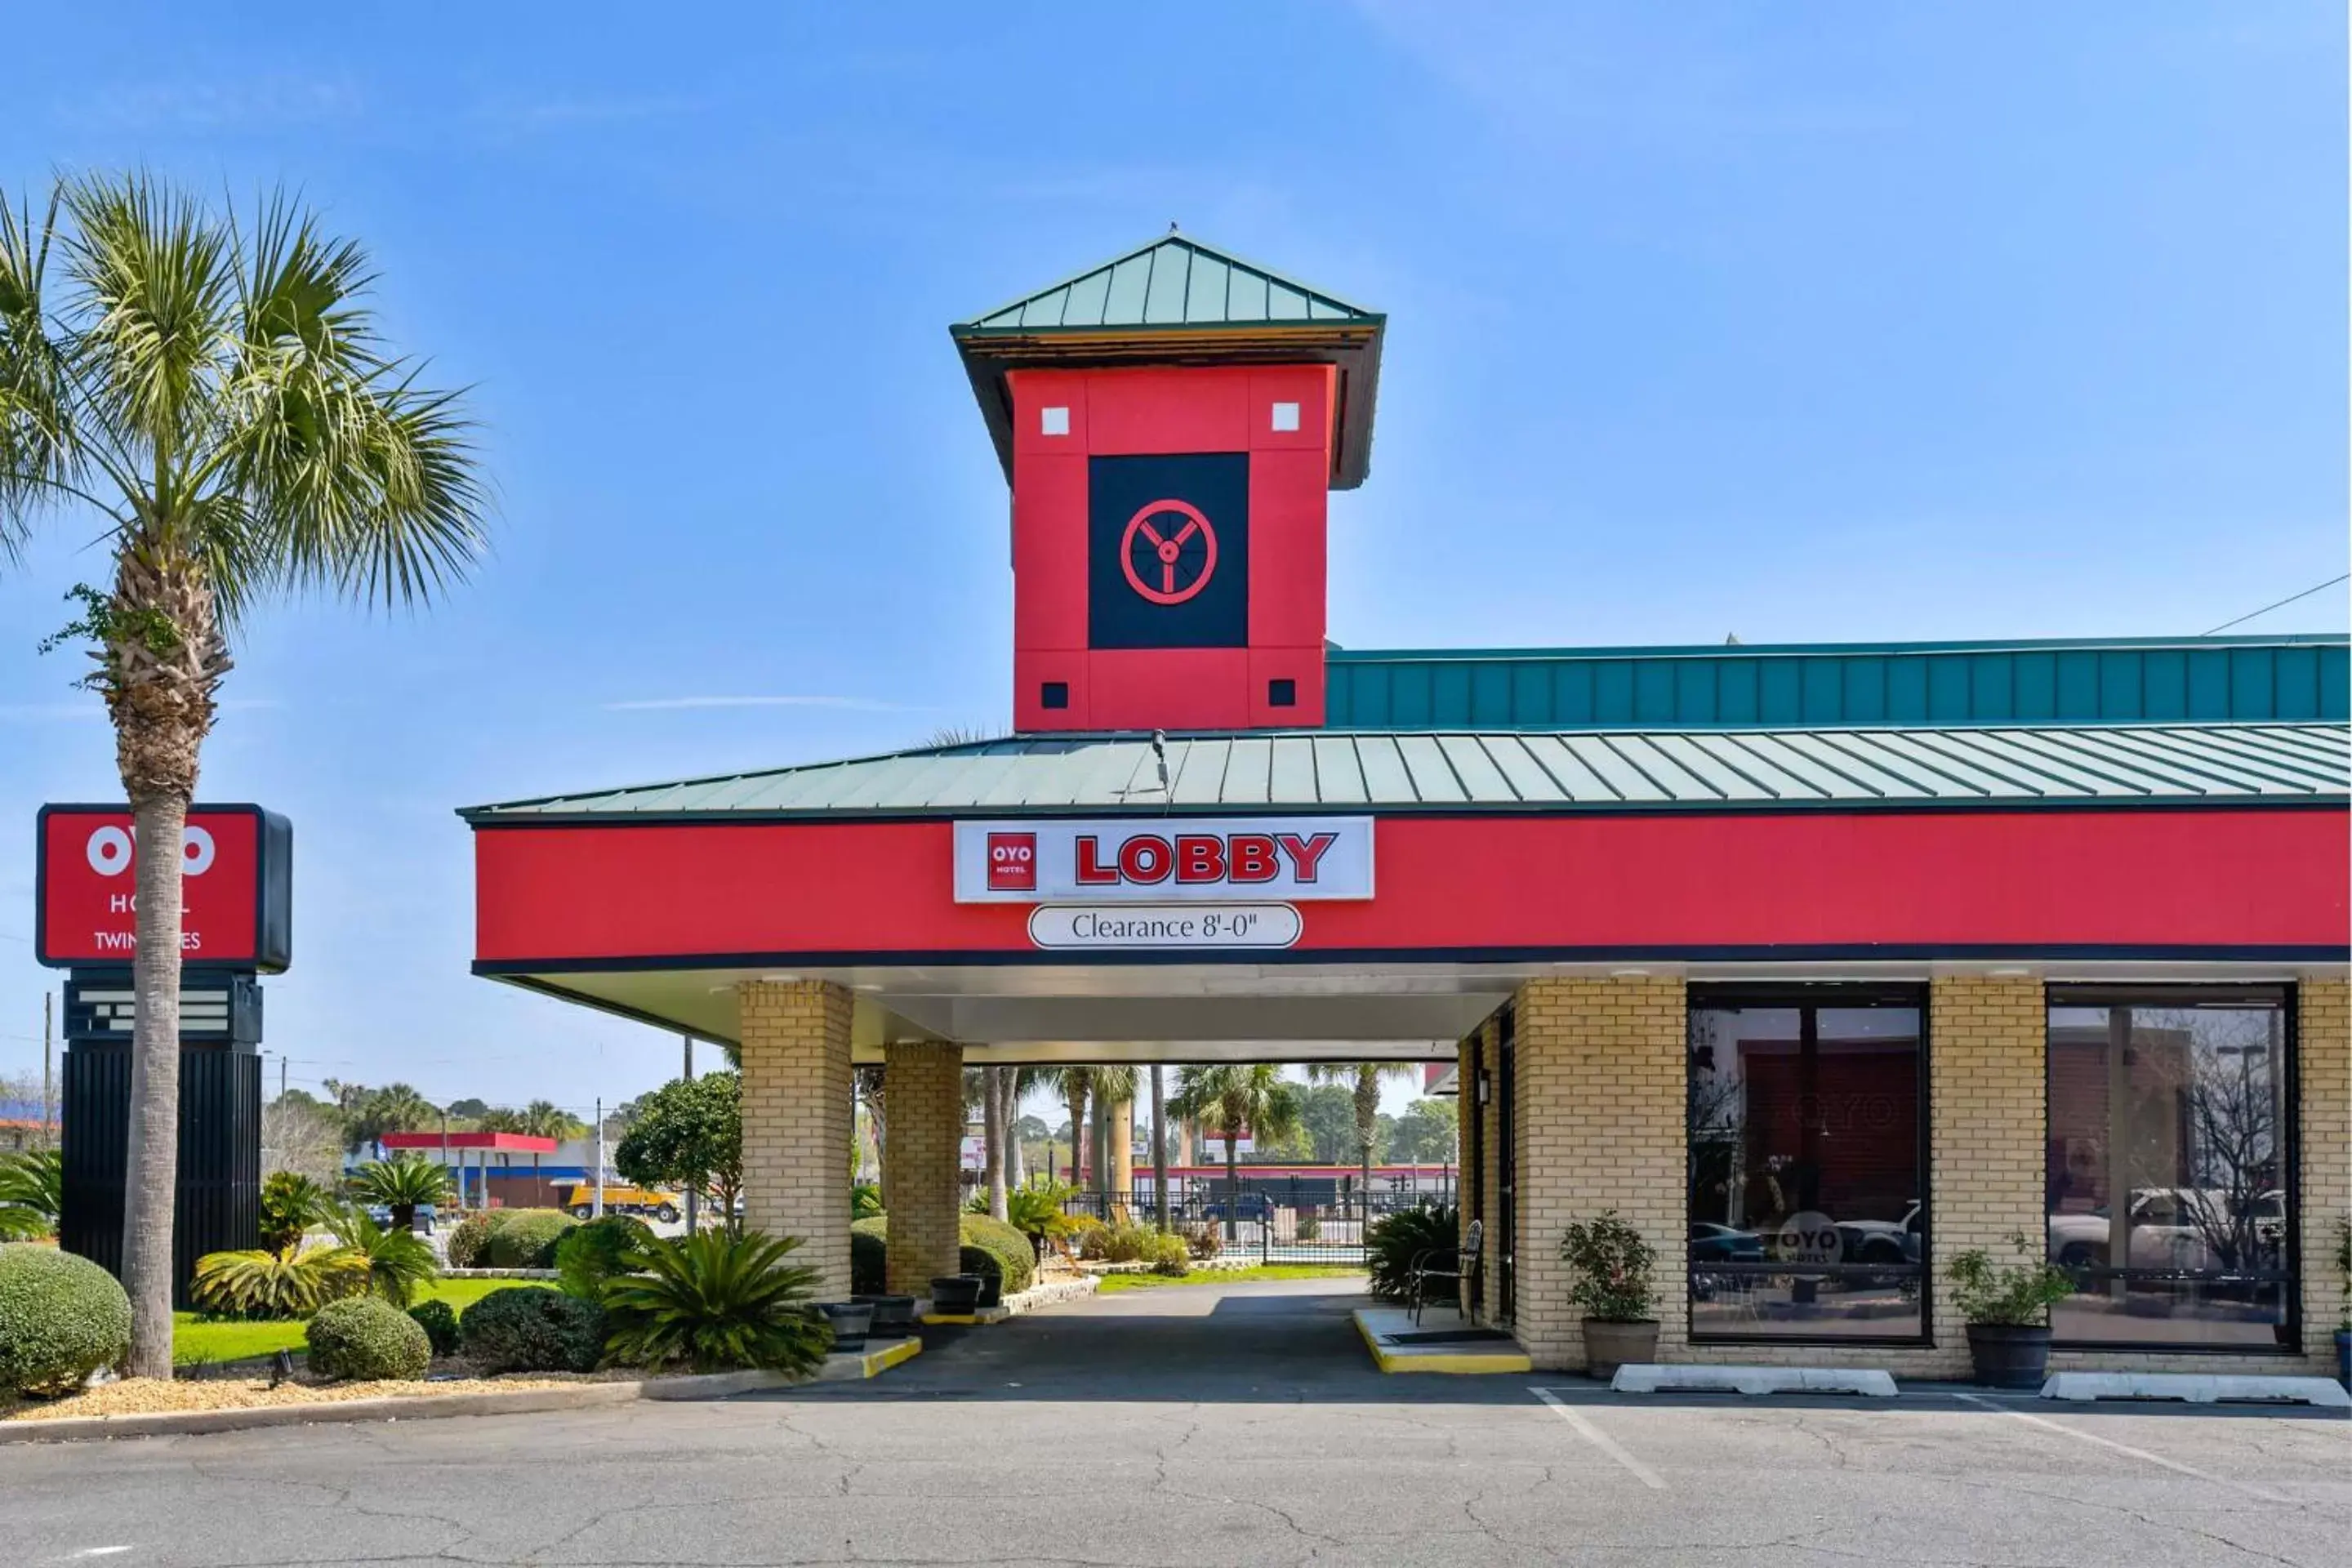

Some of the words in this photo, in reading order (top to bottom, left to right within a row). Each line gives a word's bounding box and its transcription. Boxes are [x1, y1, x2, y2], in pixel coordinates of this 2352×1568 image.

[87, 826, 216, 875] OO
[993, 846, 1031, 862] OYO
[1076, 833, 1339, 884] LOBBY
[1072, 913, 1194, 938] Clearance
[1203, 914, 1257, 937] 8'-0"
[1781, 1231, 1837, 1250] OYO
